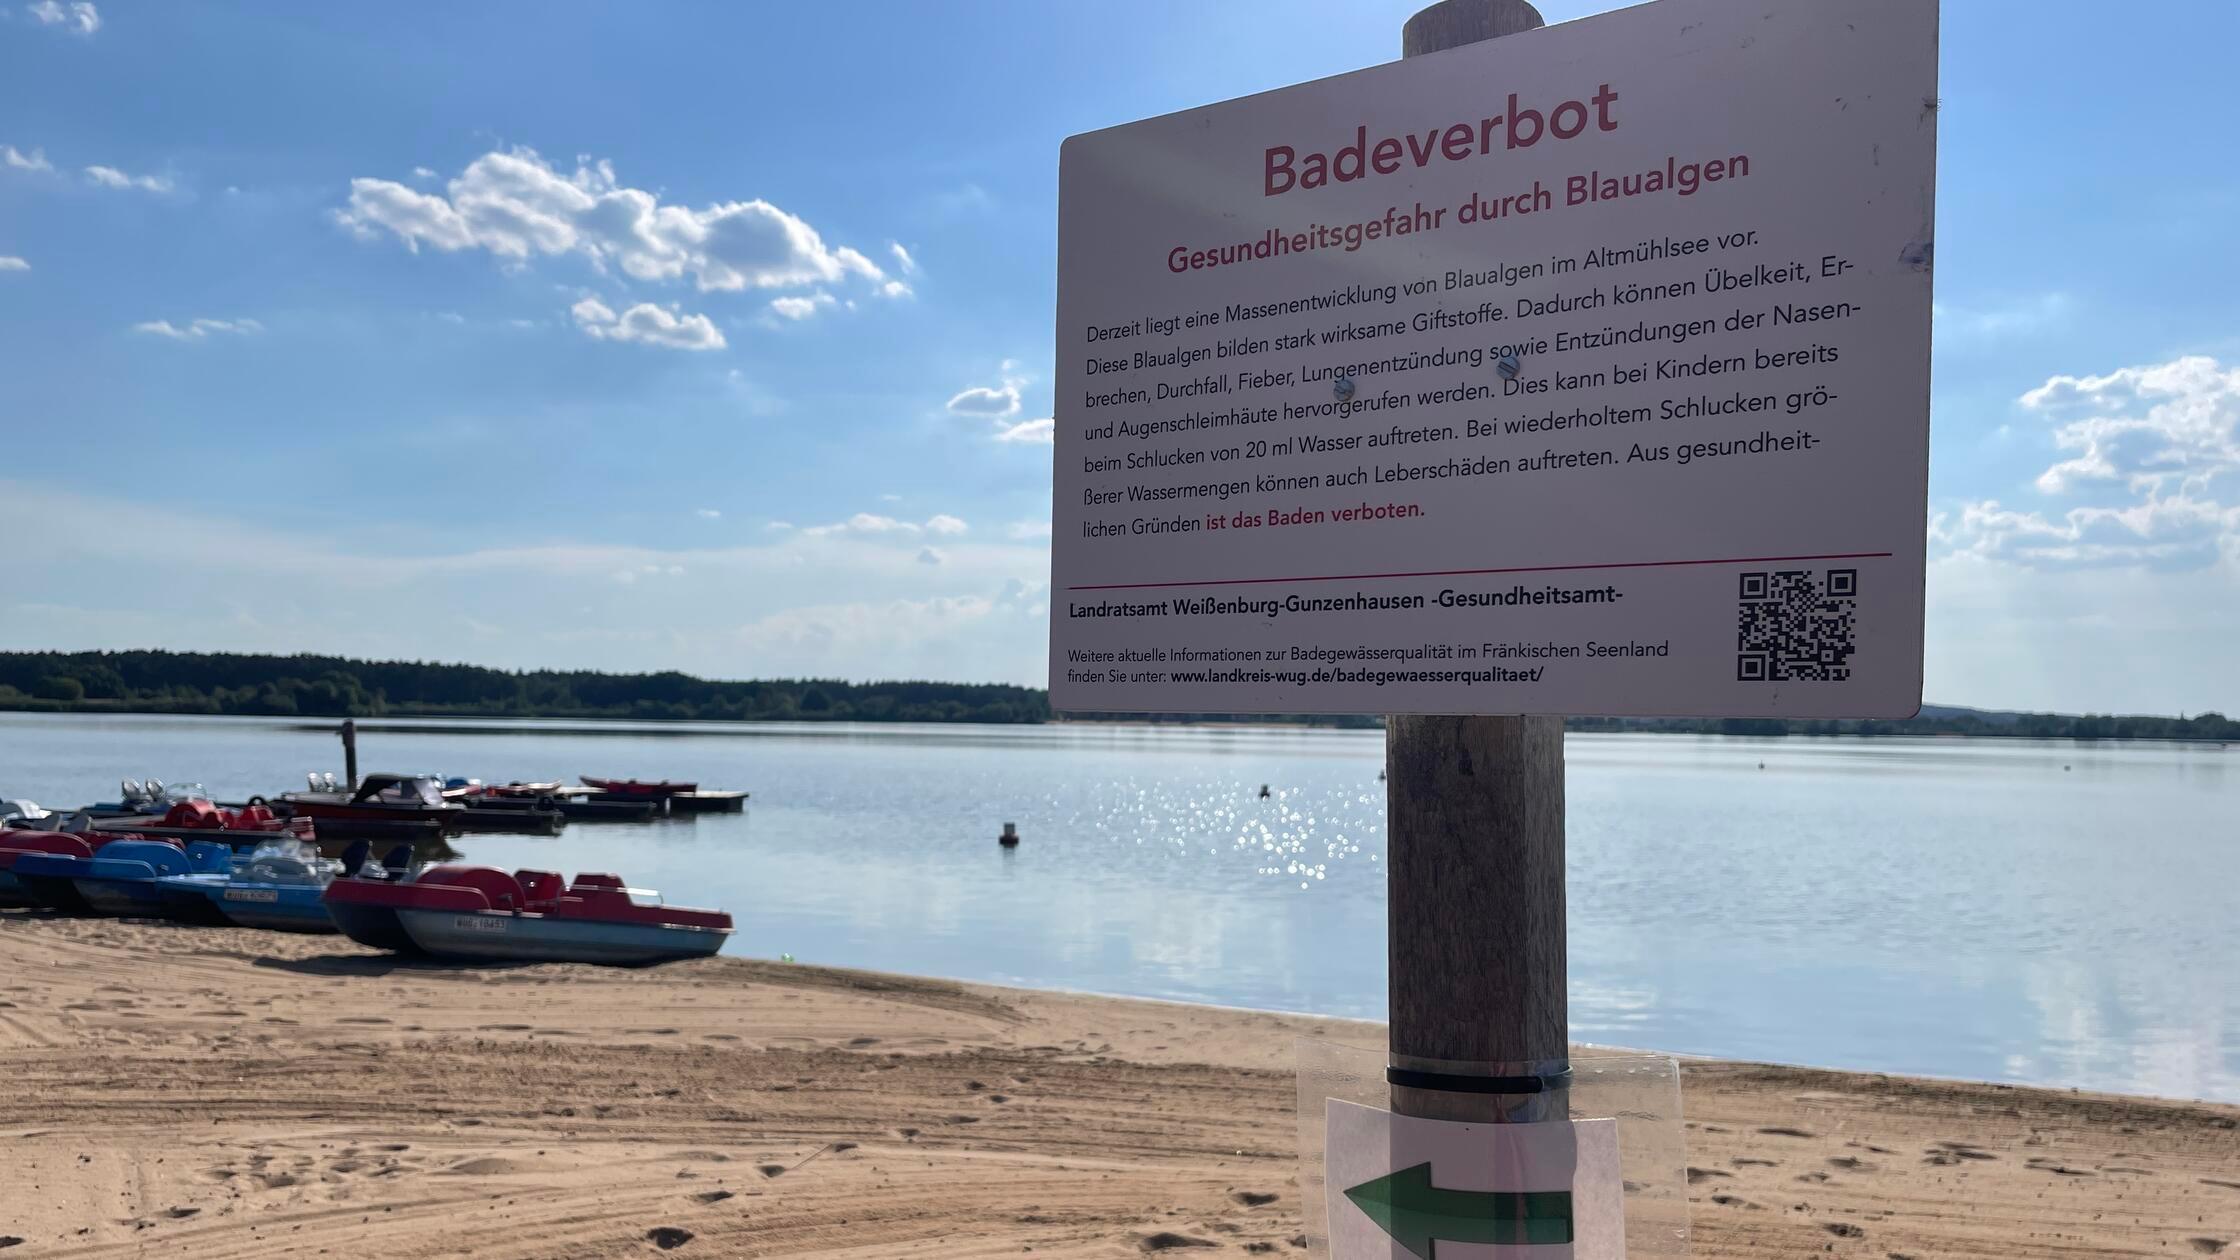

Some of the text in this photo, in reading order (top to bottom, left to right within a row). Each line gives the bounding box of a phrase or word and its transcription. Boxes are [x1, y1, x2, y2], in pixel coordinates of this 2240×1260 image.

[1264, 83, 1619, 198] Badeverbot
[1167, 154, 1750, 274] Gesundheitsgefahr durch Blaualgen
[1086, 255, 1855, 376] Diese Blaualgen bilden stark wirksame Giftstoffe. Dadurch können Übelkeit, Er-
[1087, 230, 1759, 343] Derzeit liegt eine Massenentwicklung von Blaualgen im Altmühlsee vor.
[1084, 343, 1839, 441] und Augenschleimhäute hervorgerufen werden. Dies kann bei Kindern bereits
[1085, 302, 1862, 409] brechen, Durchfall, Fieber, Lungenentzündung sowie Entzündungen der Nasen-
[1083, 429, 1821, 506] ßerer Wassermengen können auch Leberschäden auftreten. Aus gesundheit-
[1084, 384, 1839, 473] beim Schlucken von 20 ml Wasser auftreten. Bei wiederholtem Schlucken grö-
[1083, 501, 1425, 539] lichen Gründen ist das Baden verboten.
[1069, 585, 1624, 619] Landratsamt Weißenburg-Gunzenhausen -Gesundheitsamt-
[1067, 639, 1669, 665] Weitere aktuelle Informationen zur Badegewässerqualität im Fränkischen Seenland
[1067, 665, 1545, 687] finden Sie unter: www.landkreis-wug.de/badegewaesserqualitaet/
